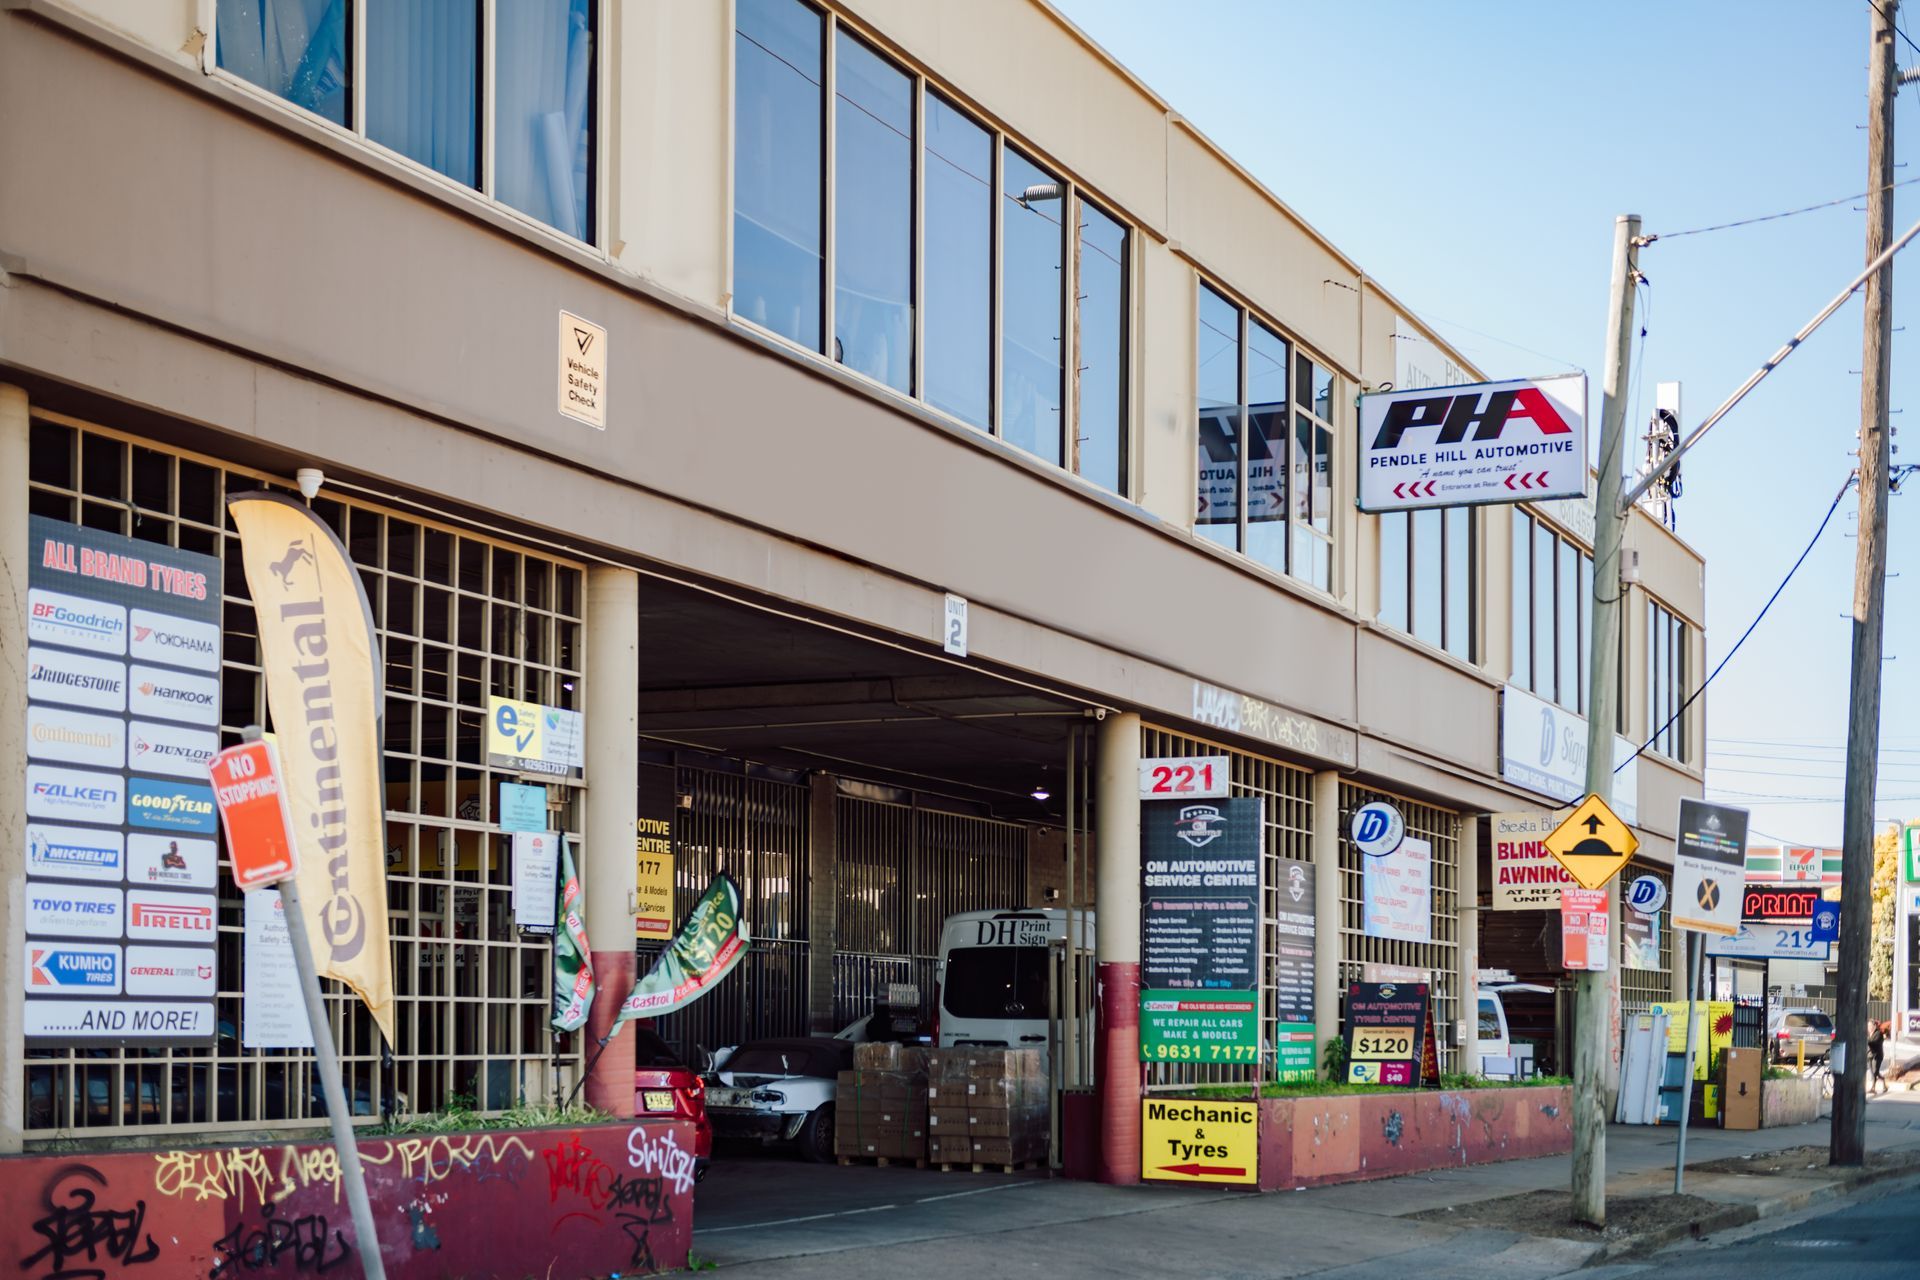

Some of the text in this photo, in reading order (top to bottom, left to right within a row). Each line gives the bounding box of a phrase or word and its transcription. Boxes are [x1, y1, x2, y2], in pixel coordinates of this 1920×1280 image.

[568, 357, 599, 380] Vehicle
[568, 373, 598, 396] Safety
[568, 390, 596, 409] Check
[1371, 388, 1573, 450] PHA
[1371, 440, 1573, 468] PENDLE HILL AUTOMOTIVE
[1432, 468, 1456, 478] name
[1458, 467, 1473, 479] you
[1482, 480, 1499, 489] Rear
[43, 539, 207, 601] ALL BRAND TYRES
[33, 603, 123, 631] BFGoodrich
[153, 631, 215, 654] YOKOHAMA
[950, 618, 961, 648] 2
[30, 664, 121, 693] BRIDGESTONE
[153, 744, 213, 761] DUNLOP
[226, 753, 256, 780] NO
[280, 596, 366, 962] Continental
[1152, 763, 1212, 793] 221
[219, 774, 278, 808] STOPPING
[49, 847, 116, 863] MICHELIN
[1497, 841, 1554, 861] BLIND
[1719, 844, 1739, 855] Program
[1146, 860, 1255, 873] OM AUTOMOTIVE
[1684, 860, 1737, 876] Black Spot Program
[1790, 848, 1815, 880] 7
[1145, 874, 1257, 887] SERVICE CENTRE
[1499, 865, 1579, 885] AWNING
[33, 899, 116, 915] TOYO TIRES
[132, 903, 212, 930] PIRELLI
[976, 920, 1051, 946] DH Print
[1019, 933, 1046, 948] Sign
[1776, 929, 1815, 949] 219
[58, 955, 112, 971] KUMHO
[86, 973, 113, 983] TIRES
[1168, 979, 1182, 987] Pink
[1197, 979, 1202, 987] &
[1205, 979, 1218, 987] Blue
[1219, 979, 1232, 988] Slip
[632, 992, 670, 1010] Castrol
[132, 1010, 198, 1030] MORE!
[1153, 1019, 1243, 1028] WE REPAIR ALL CARS
[1163, 1031, 1238, 1040] MAKE & MODELS
[1358, 1037, 1409, 1054] $120
[1157, 1044, 1257, 1060] 9631 7177
[1386, 1074, 1403, 1082] $40
[1149, 1104, 1253, 1124] Mechanic
[1195, 1128, 1205, 1139] &
[1168, 1139, 1228, 1161] Tyres
